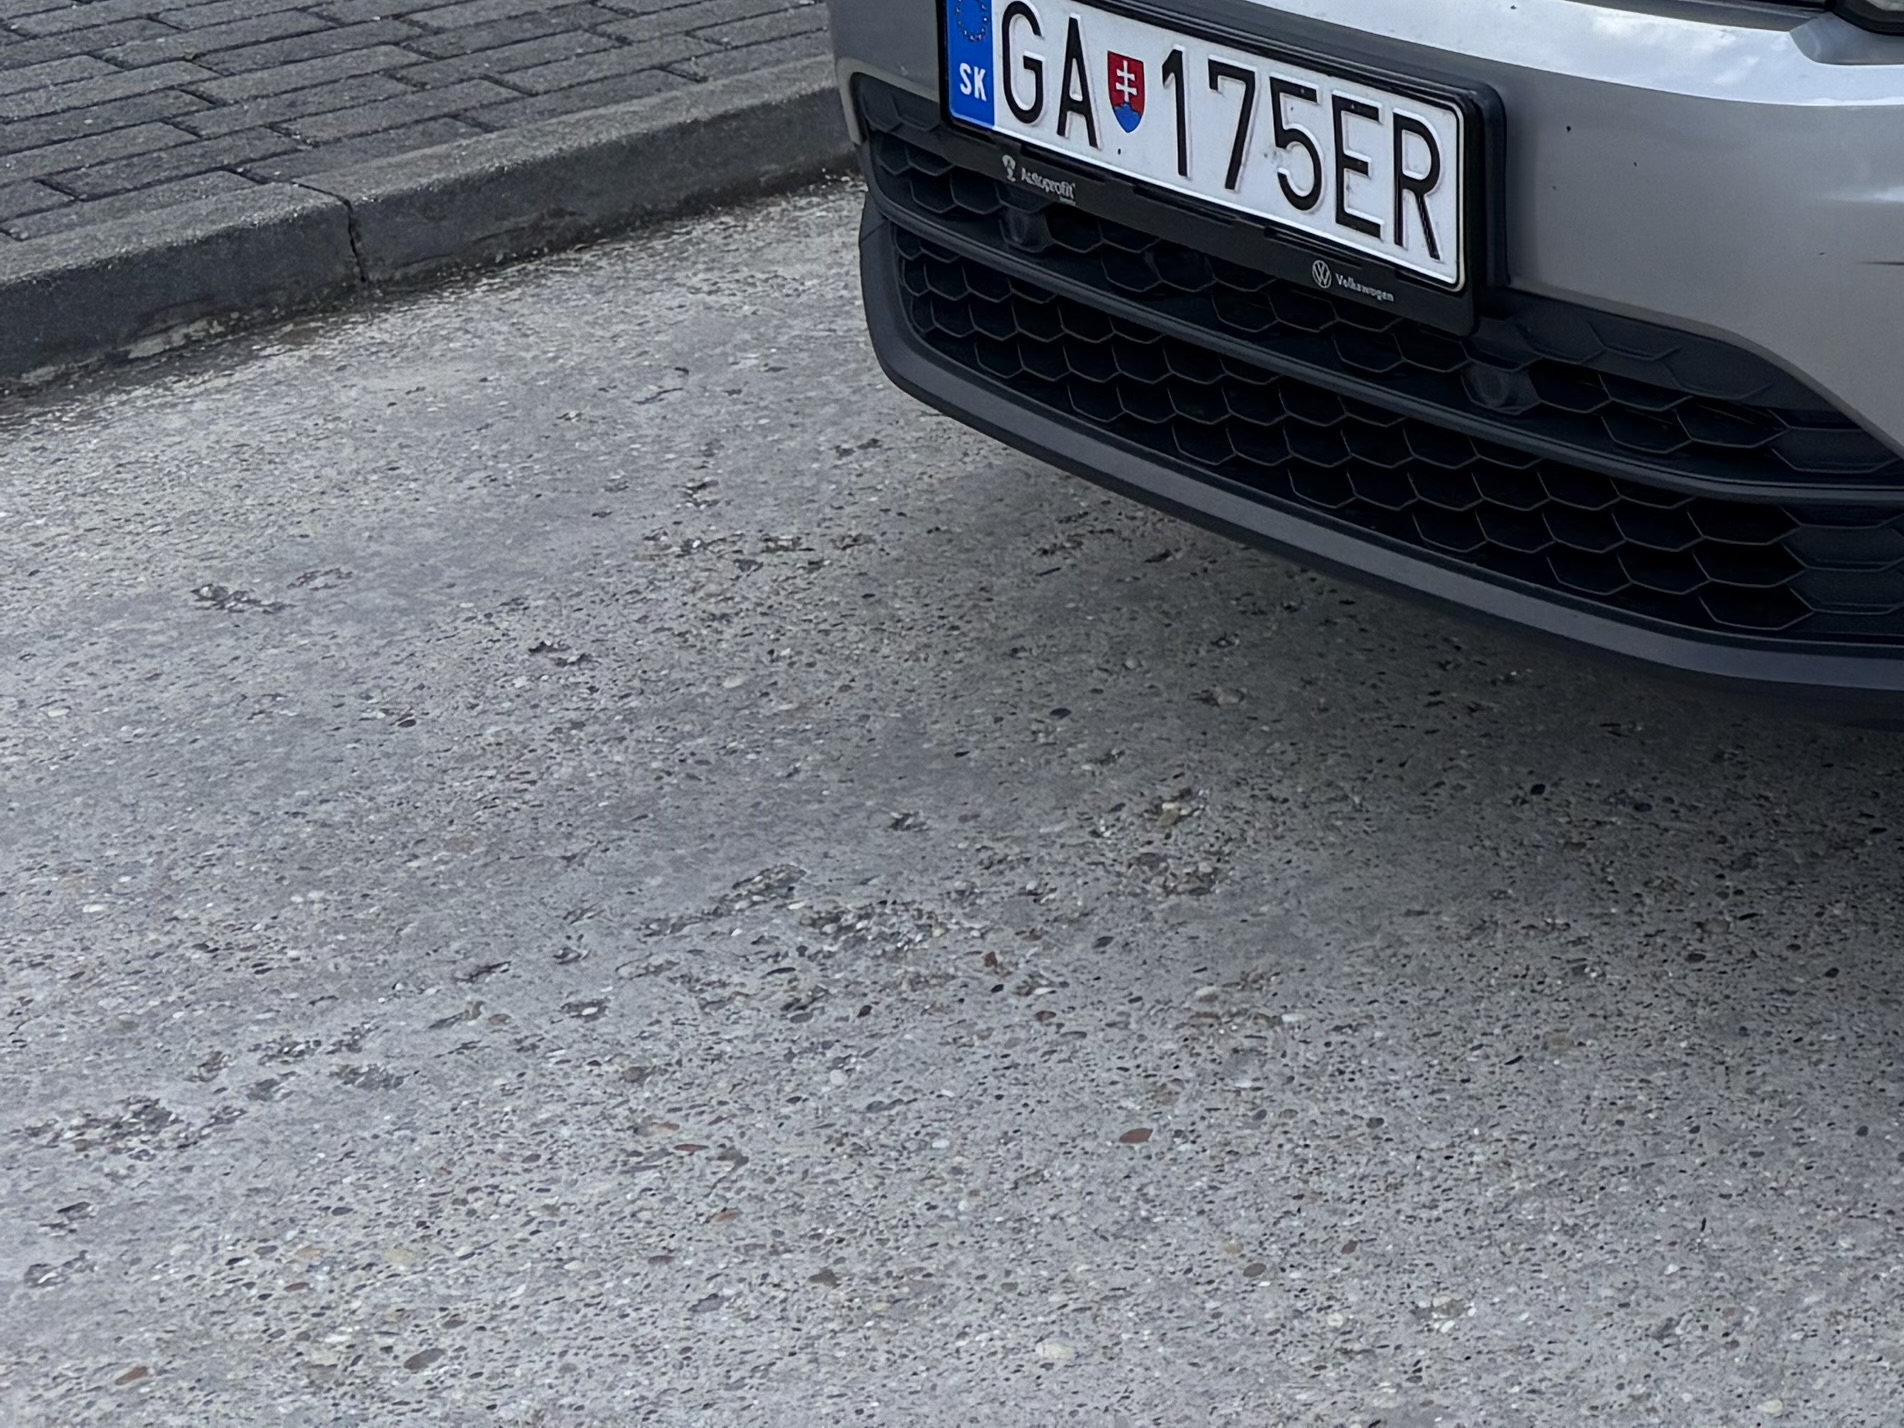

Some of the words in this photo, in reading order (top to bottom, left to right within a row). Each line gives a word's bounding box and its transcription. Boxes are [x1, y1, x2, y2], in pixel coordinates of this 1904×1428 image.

[959, 62, 988, 102] SK
[1001, 0, 1100, 148] GA
[1162, 45, 1442, 262] 175ER
[1335, 273, 1395, 302] Volkswagen
